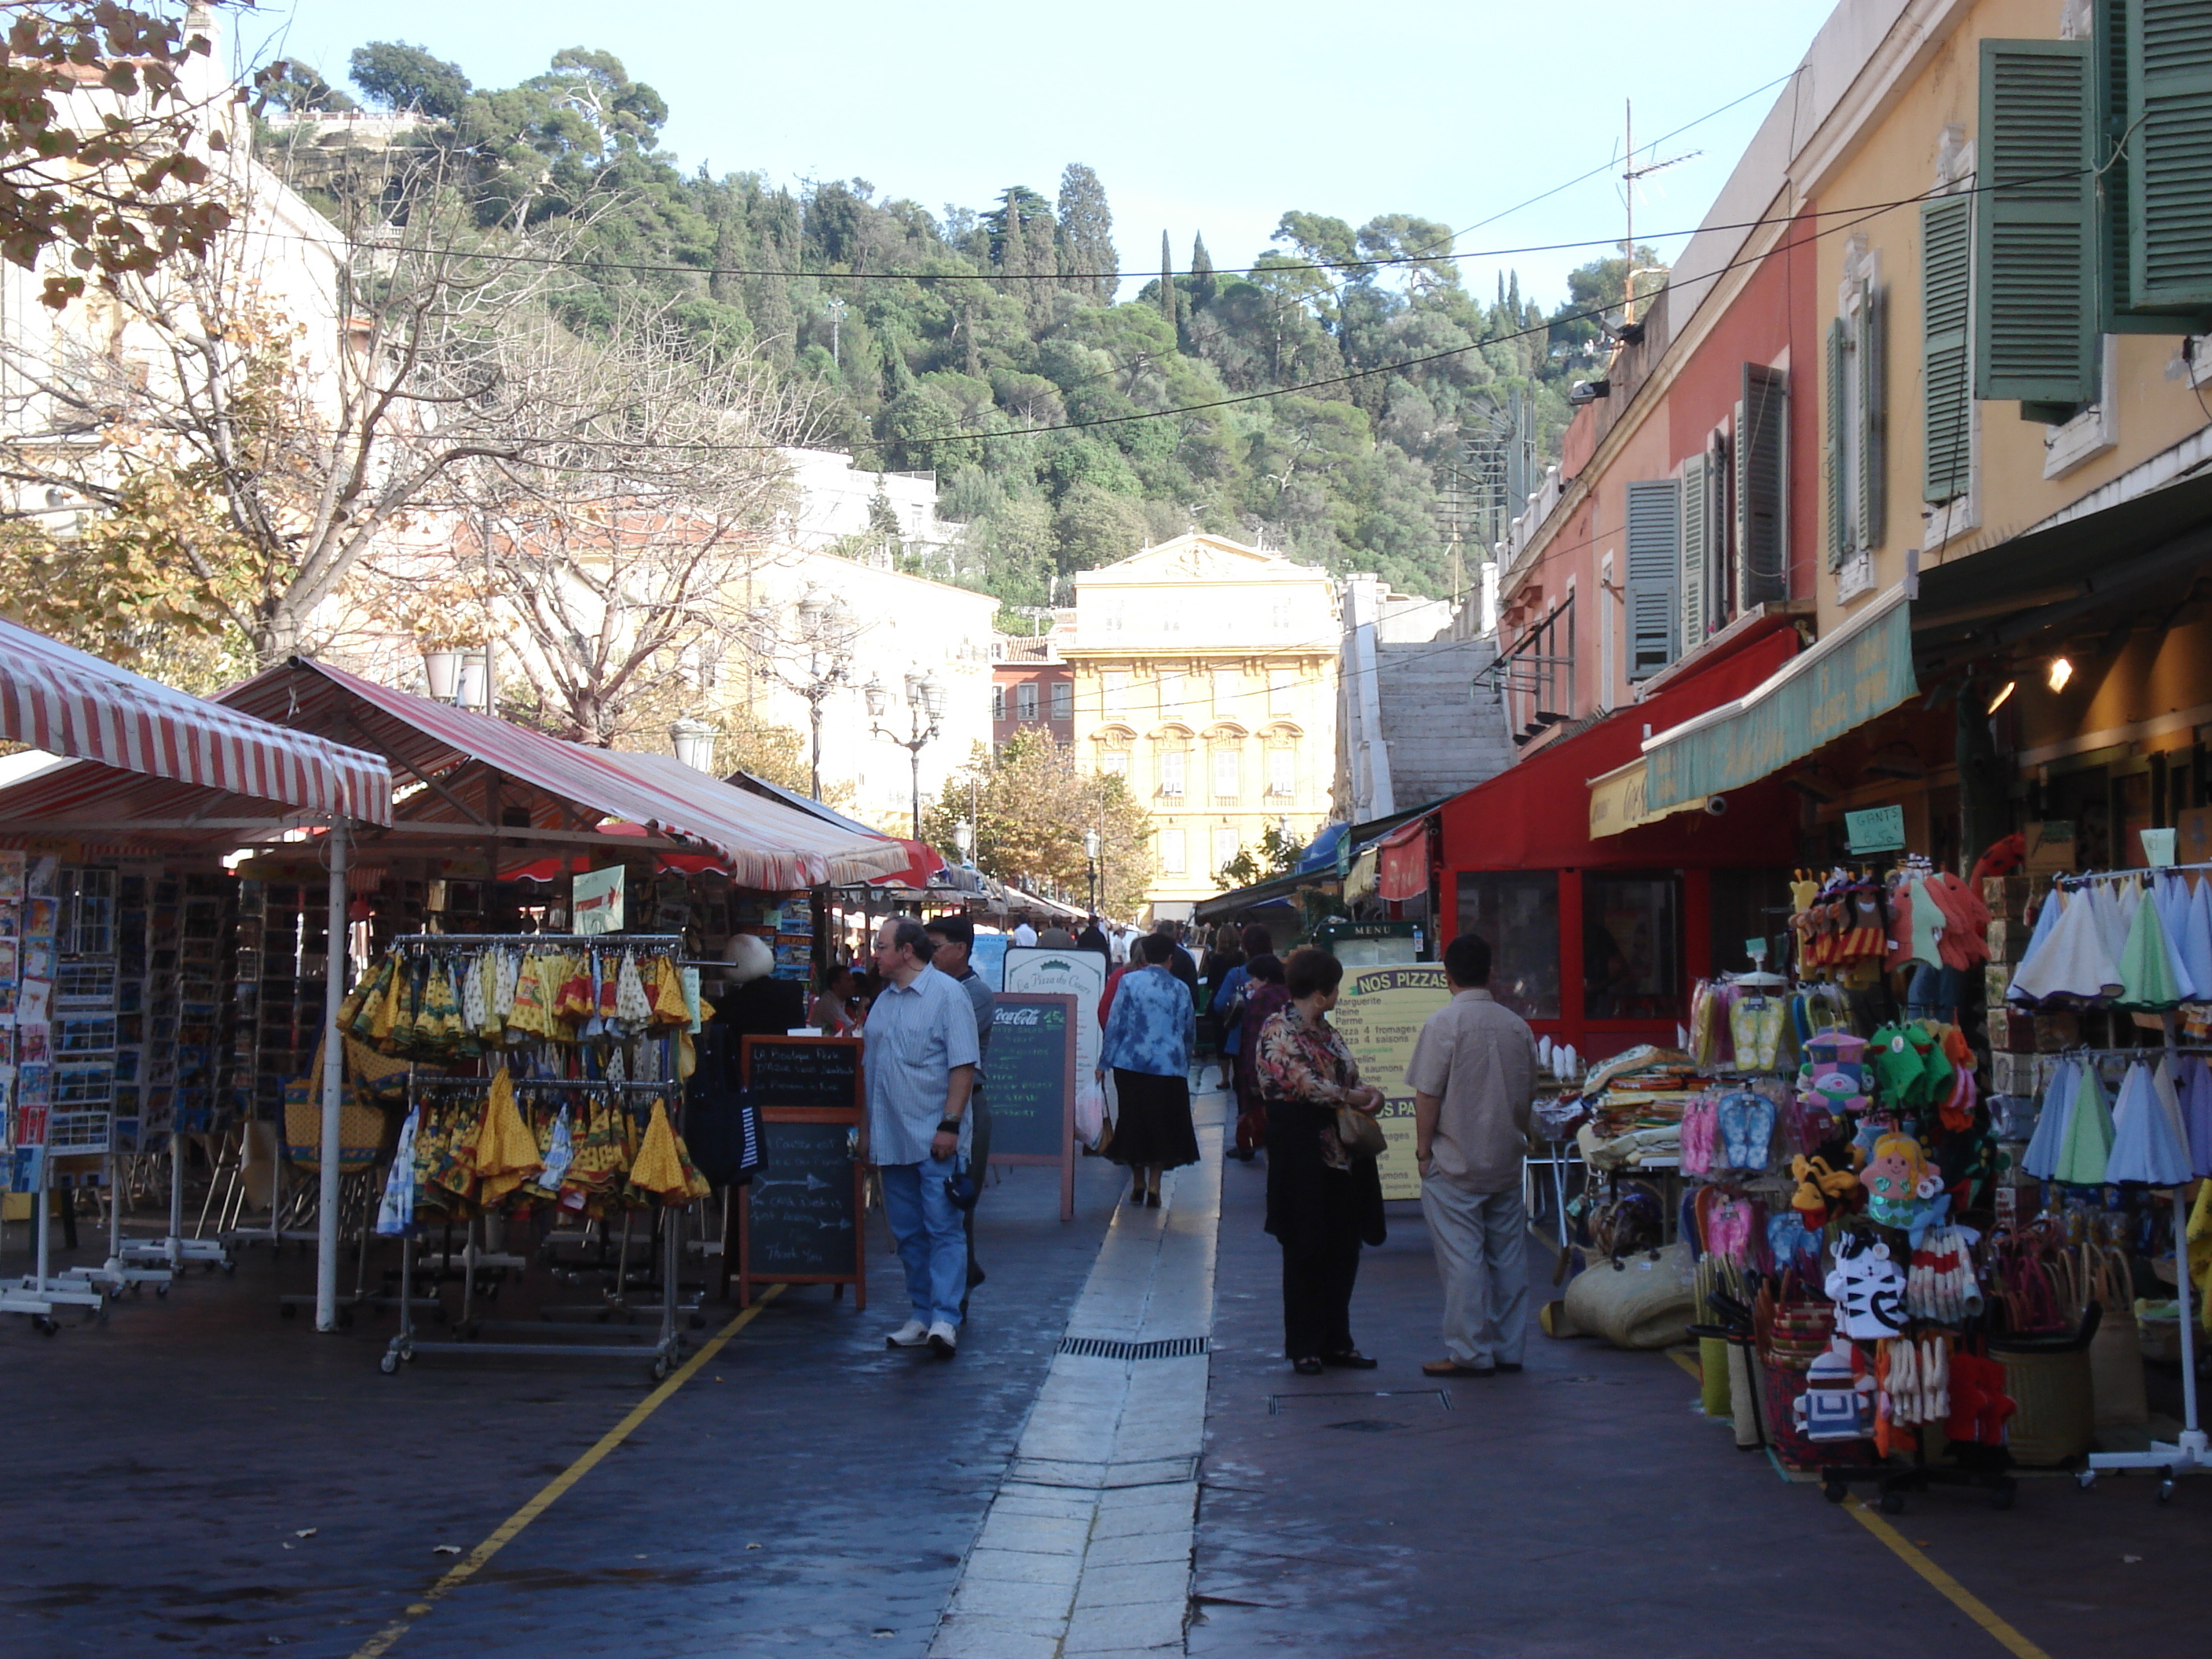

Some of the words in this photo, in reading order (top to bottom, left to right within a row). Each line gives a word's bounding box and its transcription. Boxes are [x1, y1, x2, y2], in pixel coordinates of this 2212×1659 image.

[1856, 807, 1899, 826] GANTS
[1354, 925, 1391, 935] MENU
[1017, 979, 1029, 992] La
[1031, 973, 1055, 987] Pizza
[1056, 972, 1067, 984] du
[1359, 973, 1391, 993] NOS
[1397, 972, 1448, 987] PIZZAS
[1335, 997, 1382, 1006] Marguerite
[1375, 1025, 1417, 1035] fromages
[1375, 1035, 1409, 1044] saisons
[1364, 1064, 1404, 1074] saumons
